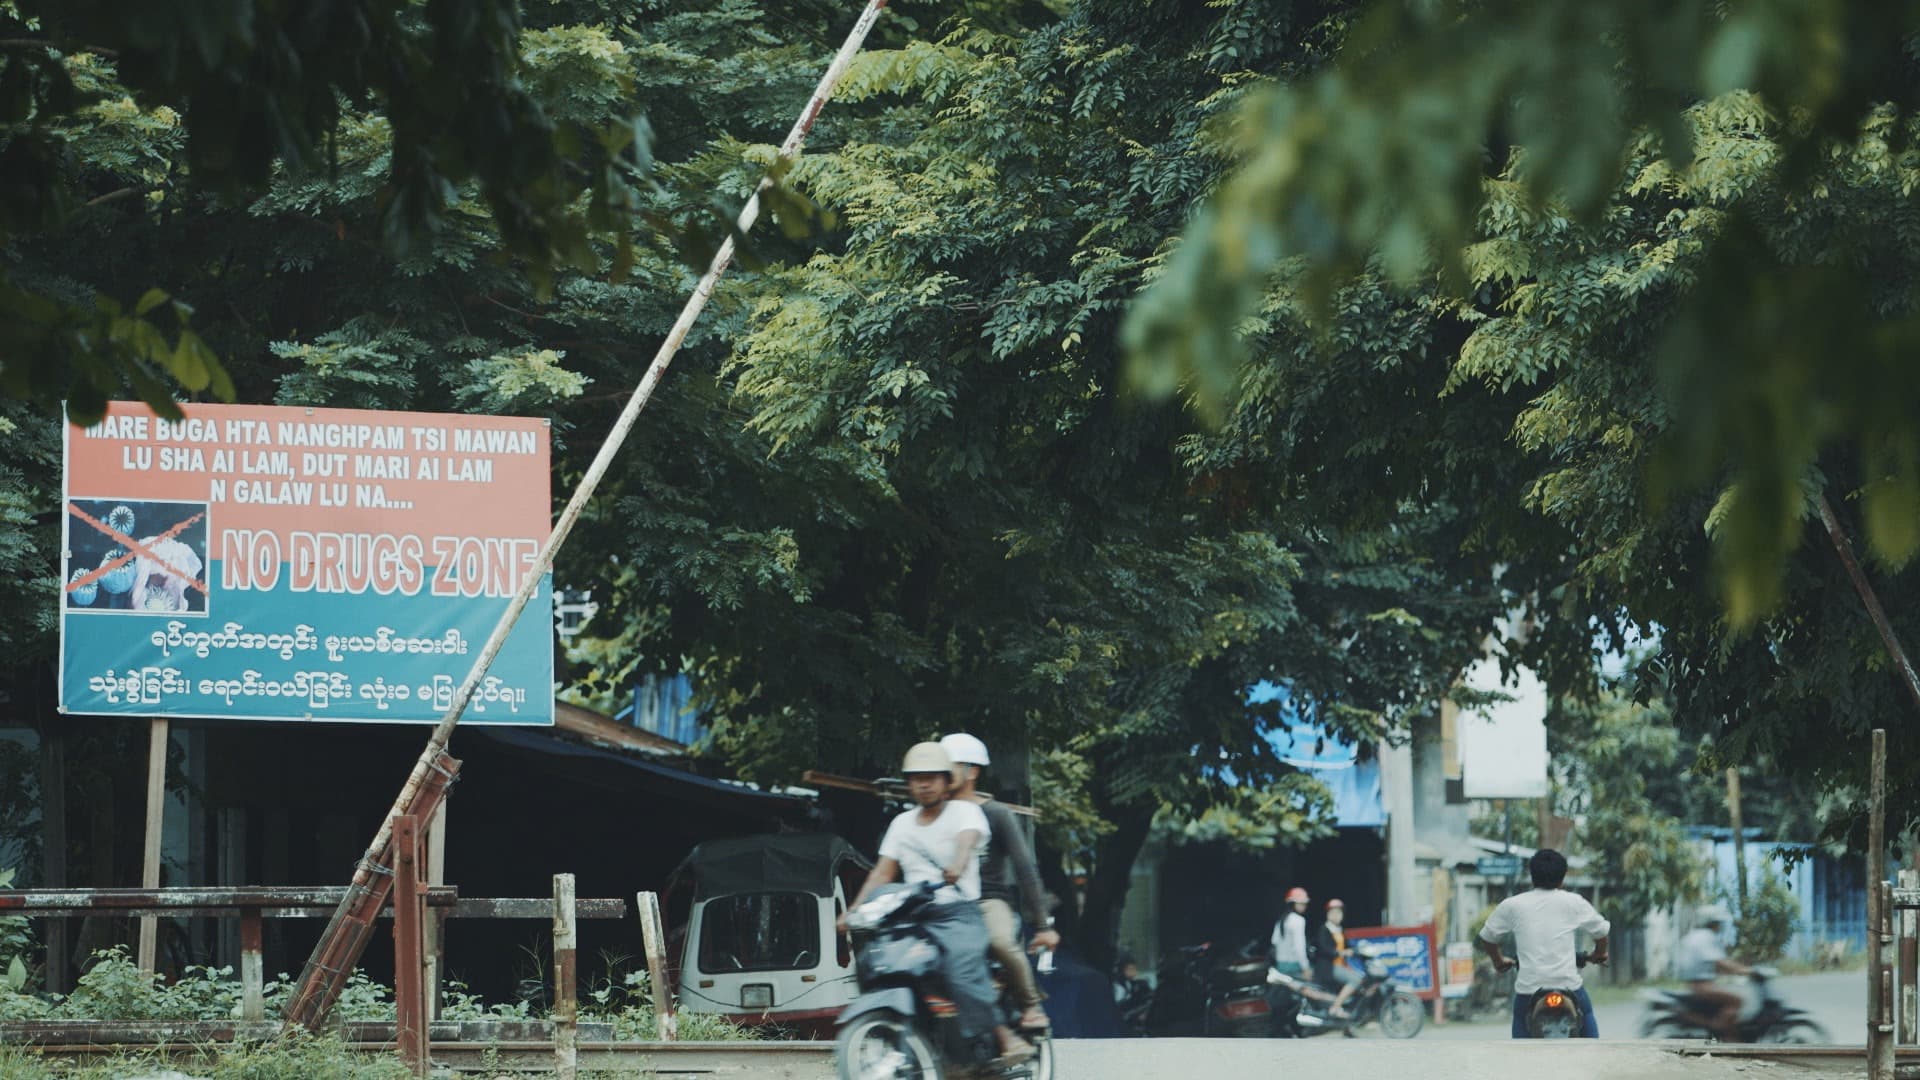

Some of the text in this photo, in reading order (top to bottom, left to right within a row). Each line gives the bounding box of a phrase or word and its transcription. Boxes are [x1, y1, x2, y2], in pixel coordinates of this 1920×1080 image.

[84, 415, 537, 454] MARE BUGA HTA NANGHPAM TSI MAWAN
[123, 446, 494, 482] LU SHA AI LAM, DUT MARI AI LAM
[211, 479, 227, 502] N
[233, 480, 314, 505] GALAW
[319, 483, 349, 507] LU
[222, 529, 539, 599] NO DRUGS ZONE
